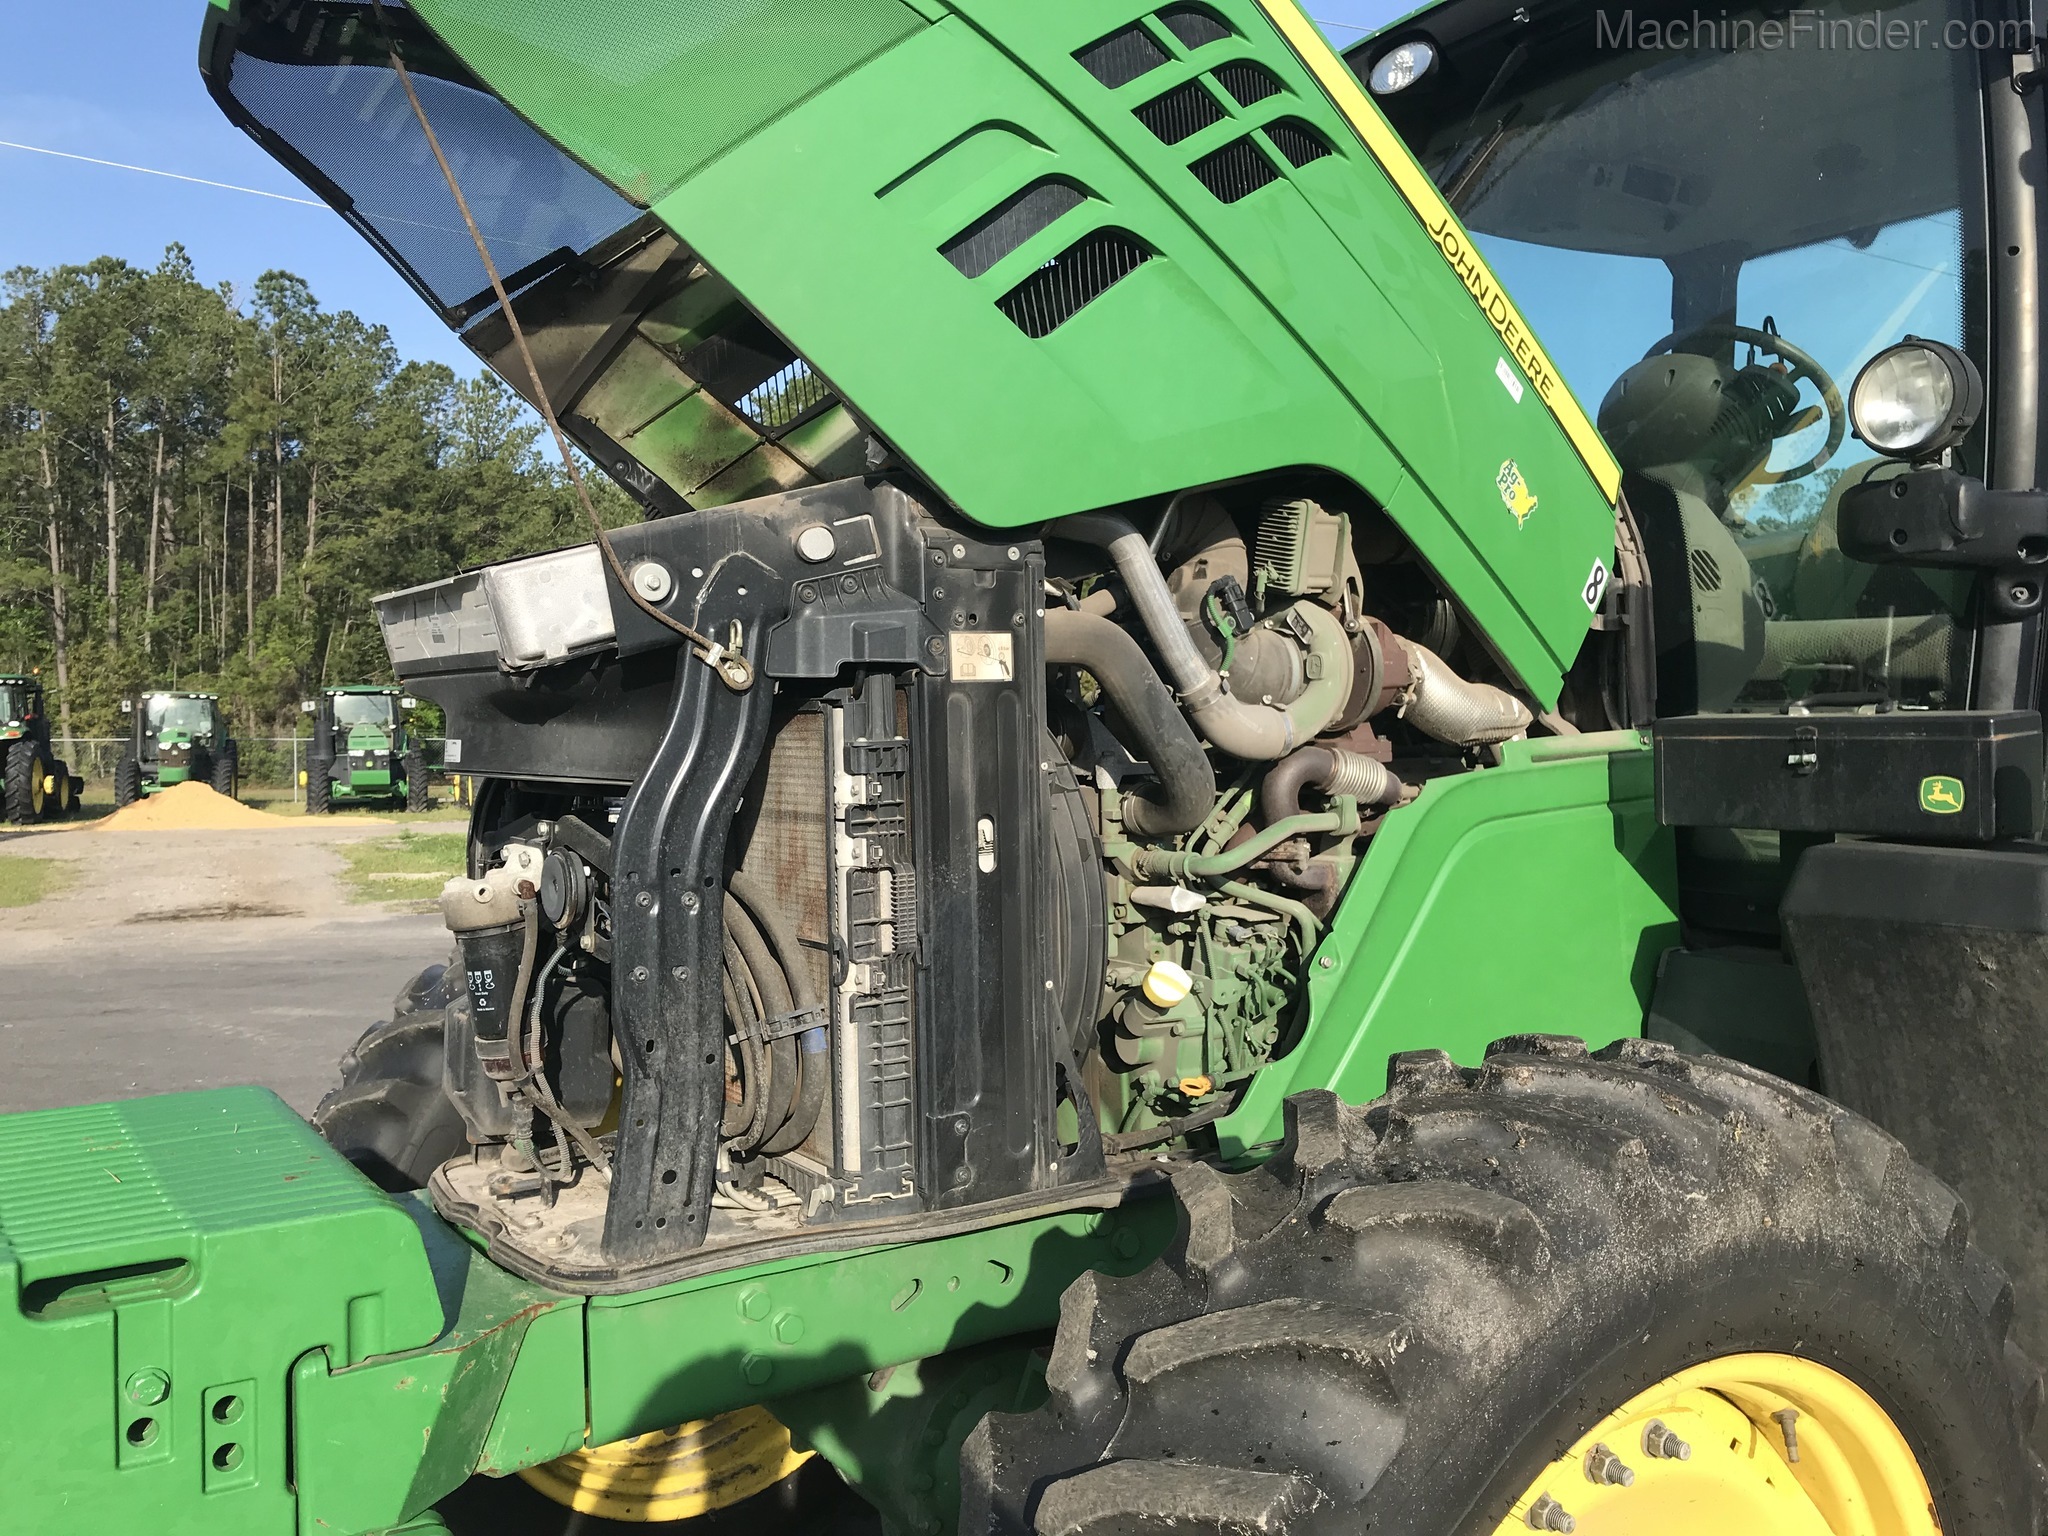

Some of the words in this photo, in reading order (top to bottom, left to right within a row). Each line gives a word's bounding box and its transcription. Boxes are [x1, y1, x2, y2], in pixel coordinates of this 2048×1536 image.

[1428, 218, 1489, 301] JOHN
[1488, 292, 1554, 400] DEERE
[1497, 472, 1516, 500] Pro
[1585, 565, 1604, 605] 8
